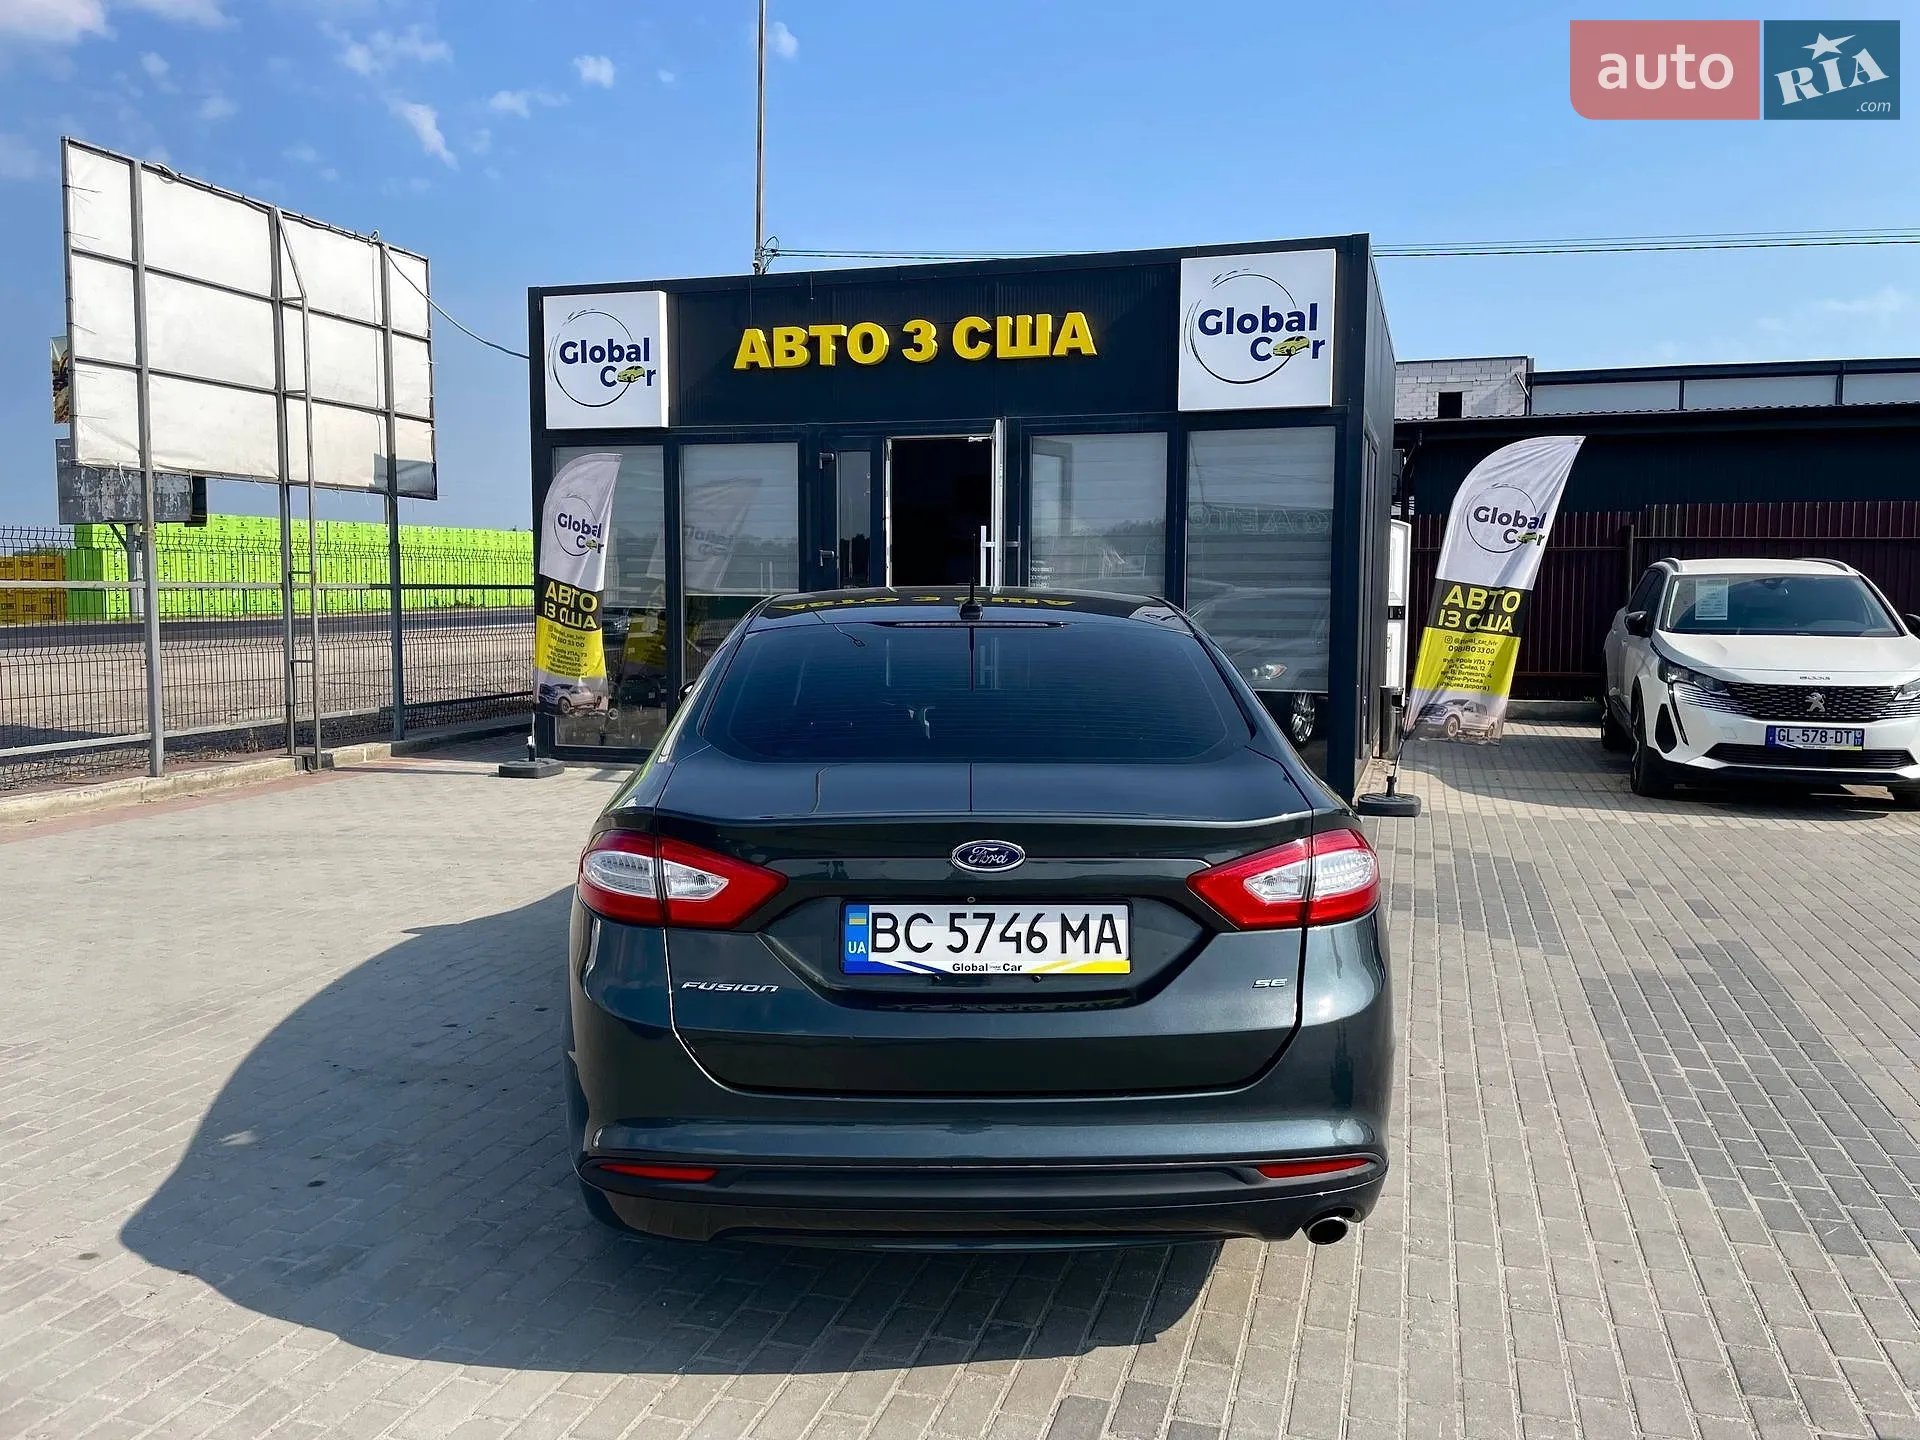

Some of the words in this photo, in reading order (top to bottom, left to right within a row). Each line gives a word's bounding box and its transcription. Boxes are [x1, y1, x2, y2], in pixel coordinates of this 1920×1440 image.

[1198, 303, 1318, 336] Global
[559, 337, 651, 364] Global
[734, 322, 890, 369] АВТО
[902, 319, 938, 363] З
[952, 312, 1098, 360] США
[1250, 335, 1326, 362] Cr
[600, 365, 656, 388] Cr
[557, 512, 602, 538] Global
[1473, 506, 1547, 530] Global
[576, 535, 604, 554] Cr
[1503, 528, 1545, 546] Cr
[545, 581, 598, 612] АВТО
[1443, 585, 1521, 613] АВТО
[544, 600, 556, 619] ІЗ
[559, 607, 597, 629] США
[1438, 609, 1461, 628] ІЗ
[1465, 613, 1513, 634] США
[1778, 728, 1852, 745] GL-578-DT
[968, 846, 1008, 864] Ford
[871, 912, 934, 954] BC
[946, 912, 1048, 954] 5746
[1060, 913, 1123, 954] MA
[848, 941, 867, 954] UA
[952, 963, 988, 971] Global
[1002, 963, 1022, 971] Car
[1252, 978, 1288, 988] SE
